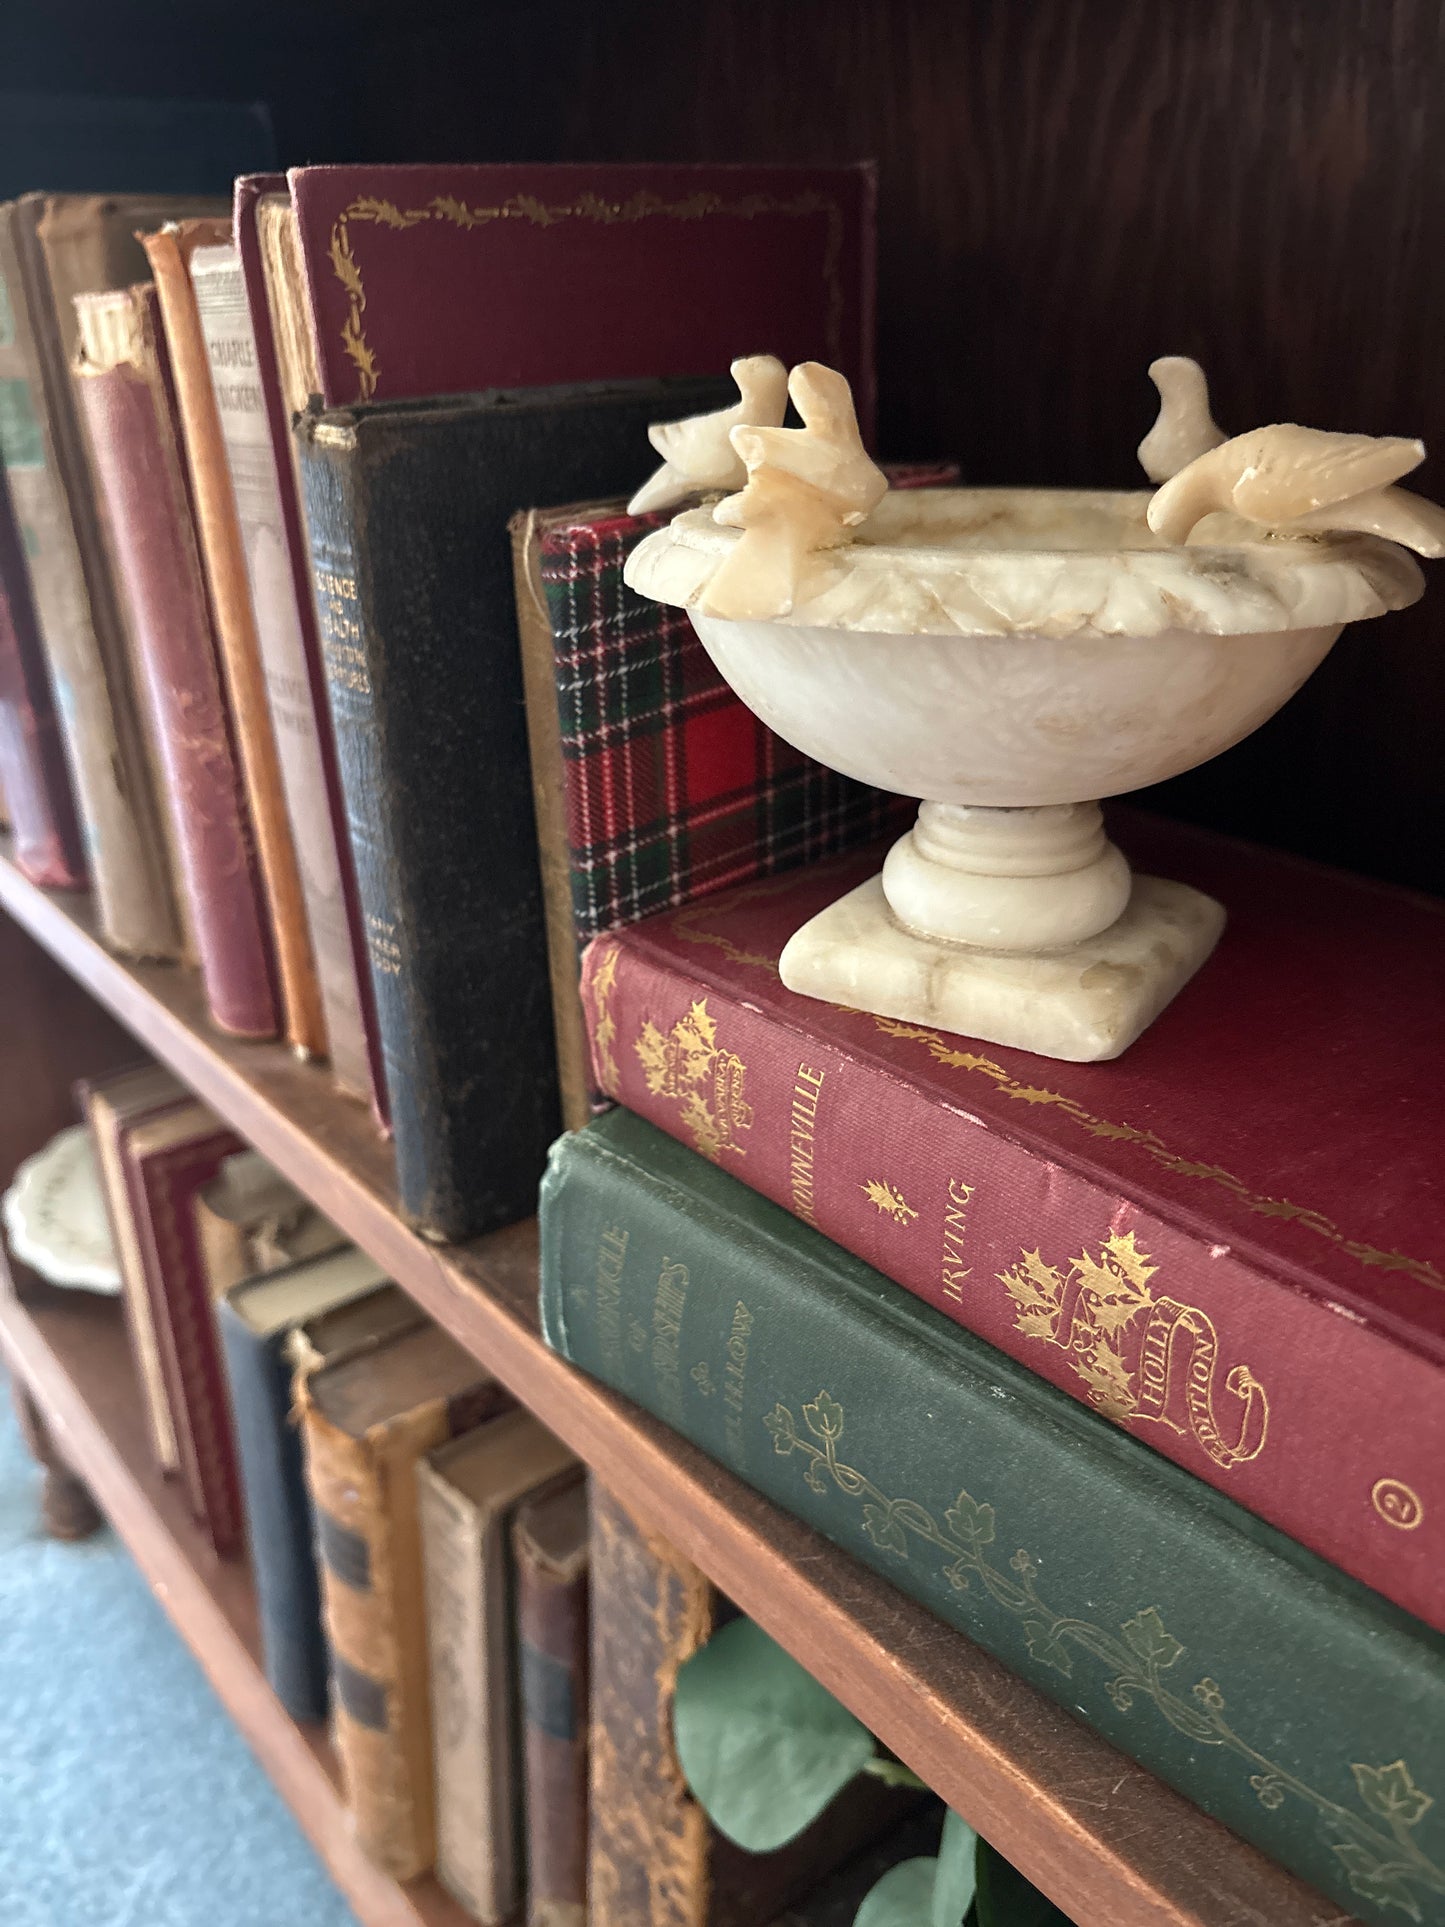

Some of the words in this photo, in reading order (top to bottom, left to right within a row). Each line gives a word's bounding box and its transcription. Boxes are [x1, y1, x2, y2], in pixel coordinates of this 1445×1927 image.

[790, 1062, 825, 1226] BONNEVILLE
[942, 1177, 976, 1304] IRVING
[1142, 1308, 1171, 1407] HOLLY
[1190, 1339, 1232, 1458] EDITION
[1383, 1492, 1411, 1520] 2
